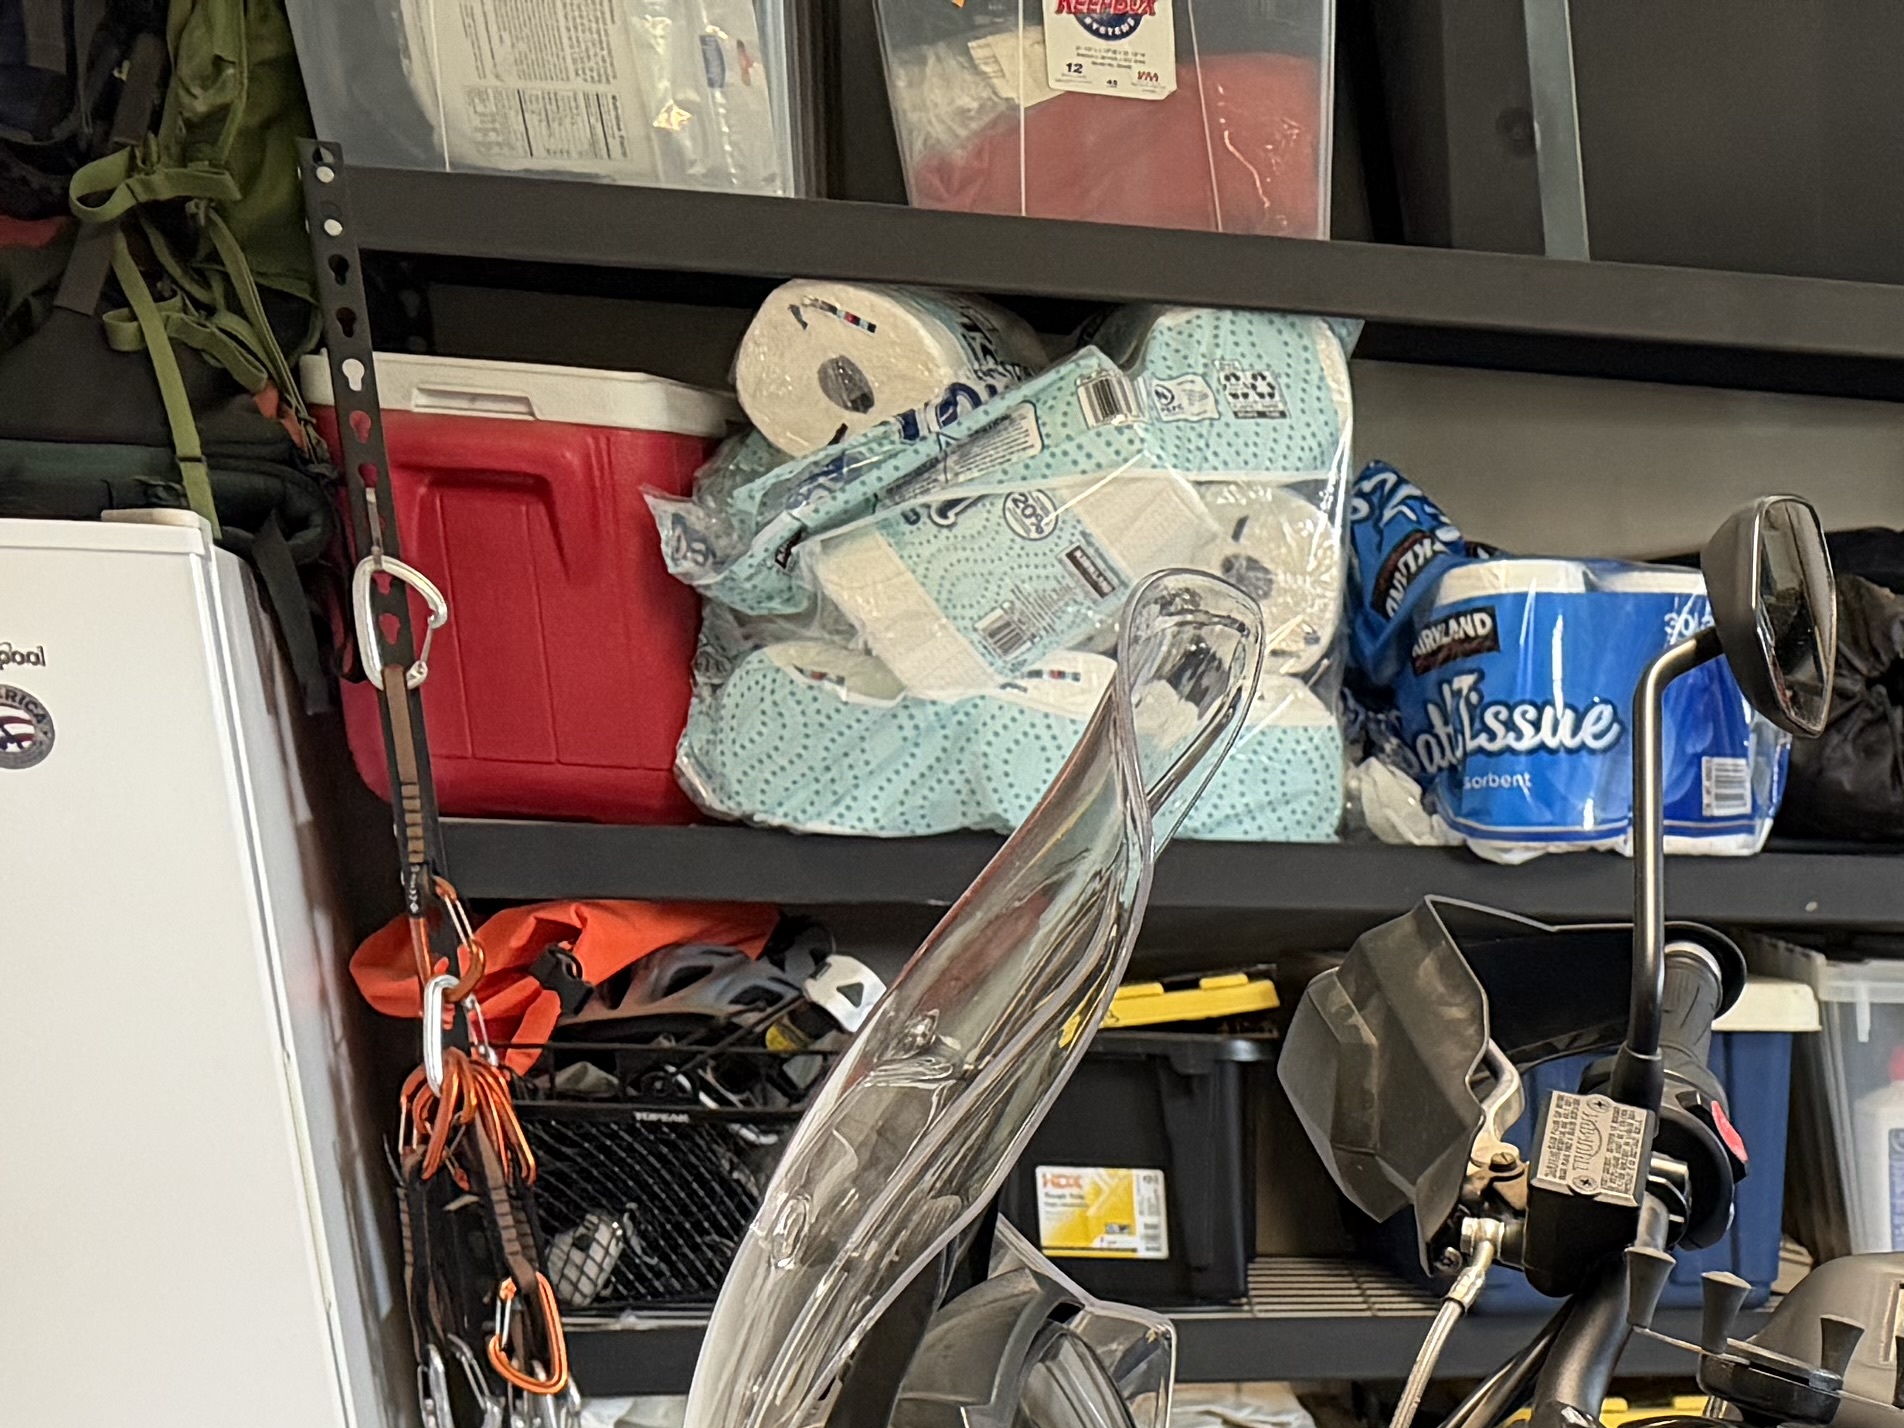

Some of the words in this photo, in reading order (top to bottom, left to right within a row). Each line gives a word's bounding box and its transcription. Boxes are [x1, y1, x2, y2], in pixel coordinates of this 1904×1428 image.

[1065, 62, 1084, 74] 12
[0, 688, 47, 725] RICA
[1463, 771, 1533, 790] sorbent
